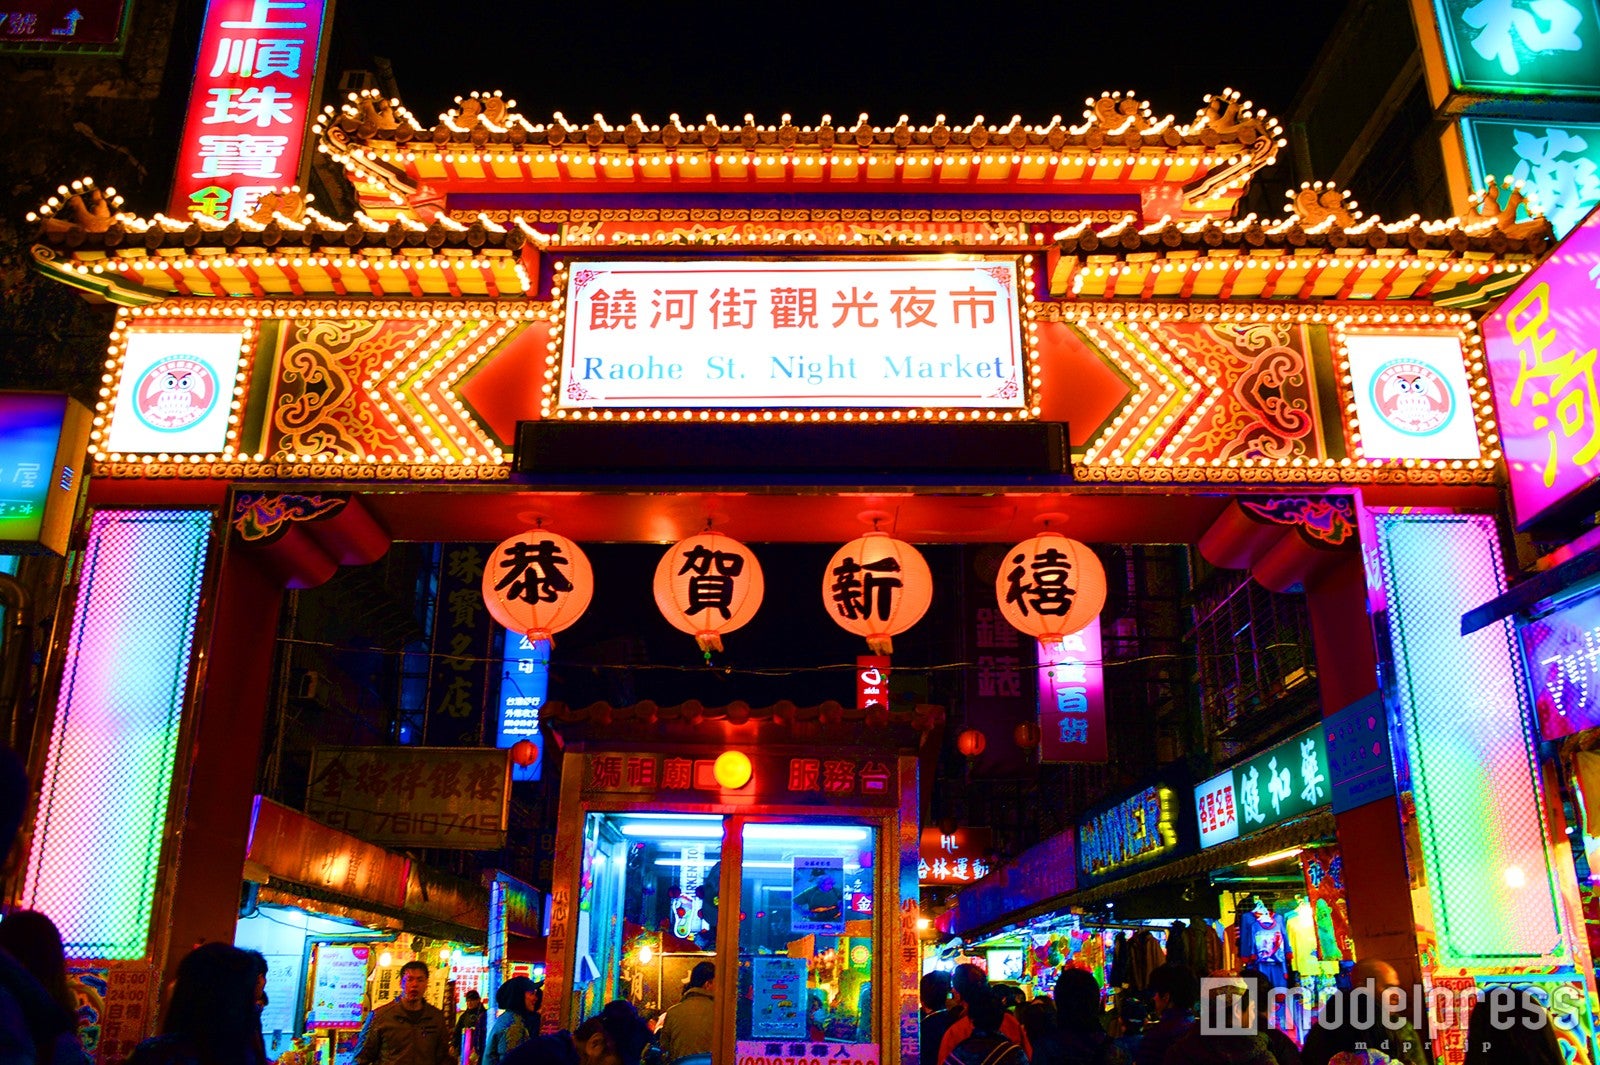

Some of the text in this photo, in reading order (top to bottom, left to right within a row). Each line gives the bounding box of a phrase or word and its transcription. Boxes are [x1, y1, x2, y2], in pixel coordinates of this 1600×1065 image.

[589, 286, 997, 330] 饒河街觀光夜市
[582, 355, 1006, 385] Raohe St. Night Market
[494, 540, 1076, 621] 恭 賀 新 禧
[437, 545, 483, 718] 珠寶名店
[787, 757, 891, 795] 服務台
[374, 812, 499, 836] 7610745
[550, 890, 570, 955] 小心扒手
[901, 898, 918, 962] 小心扒手
[113, 973, 146, 985] 16:00
